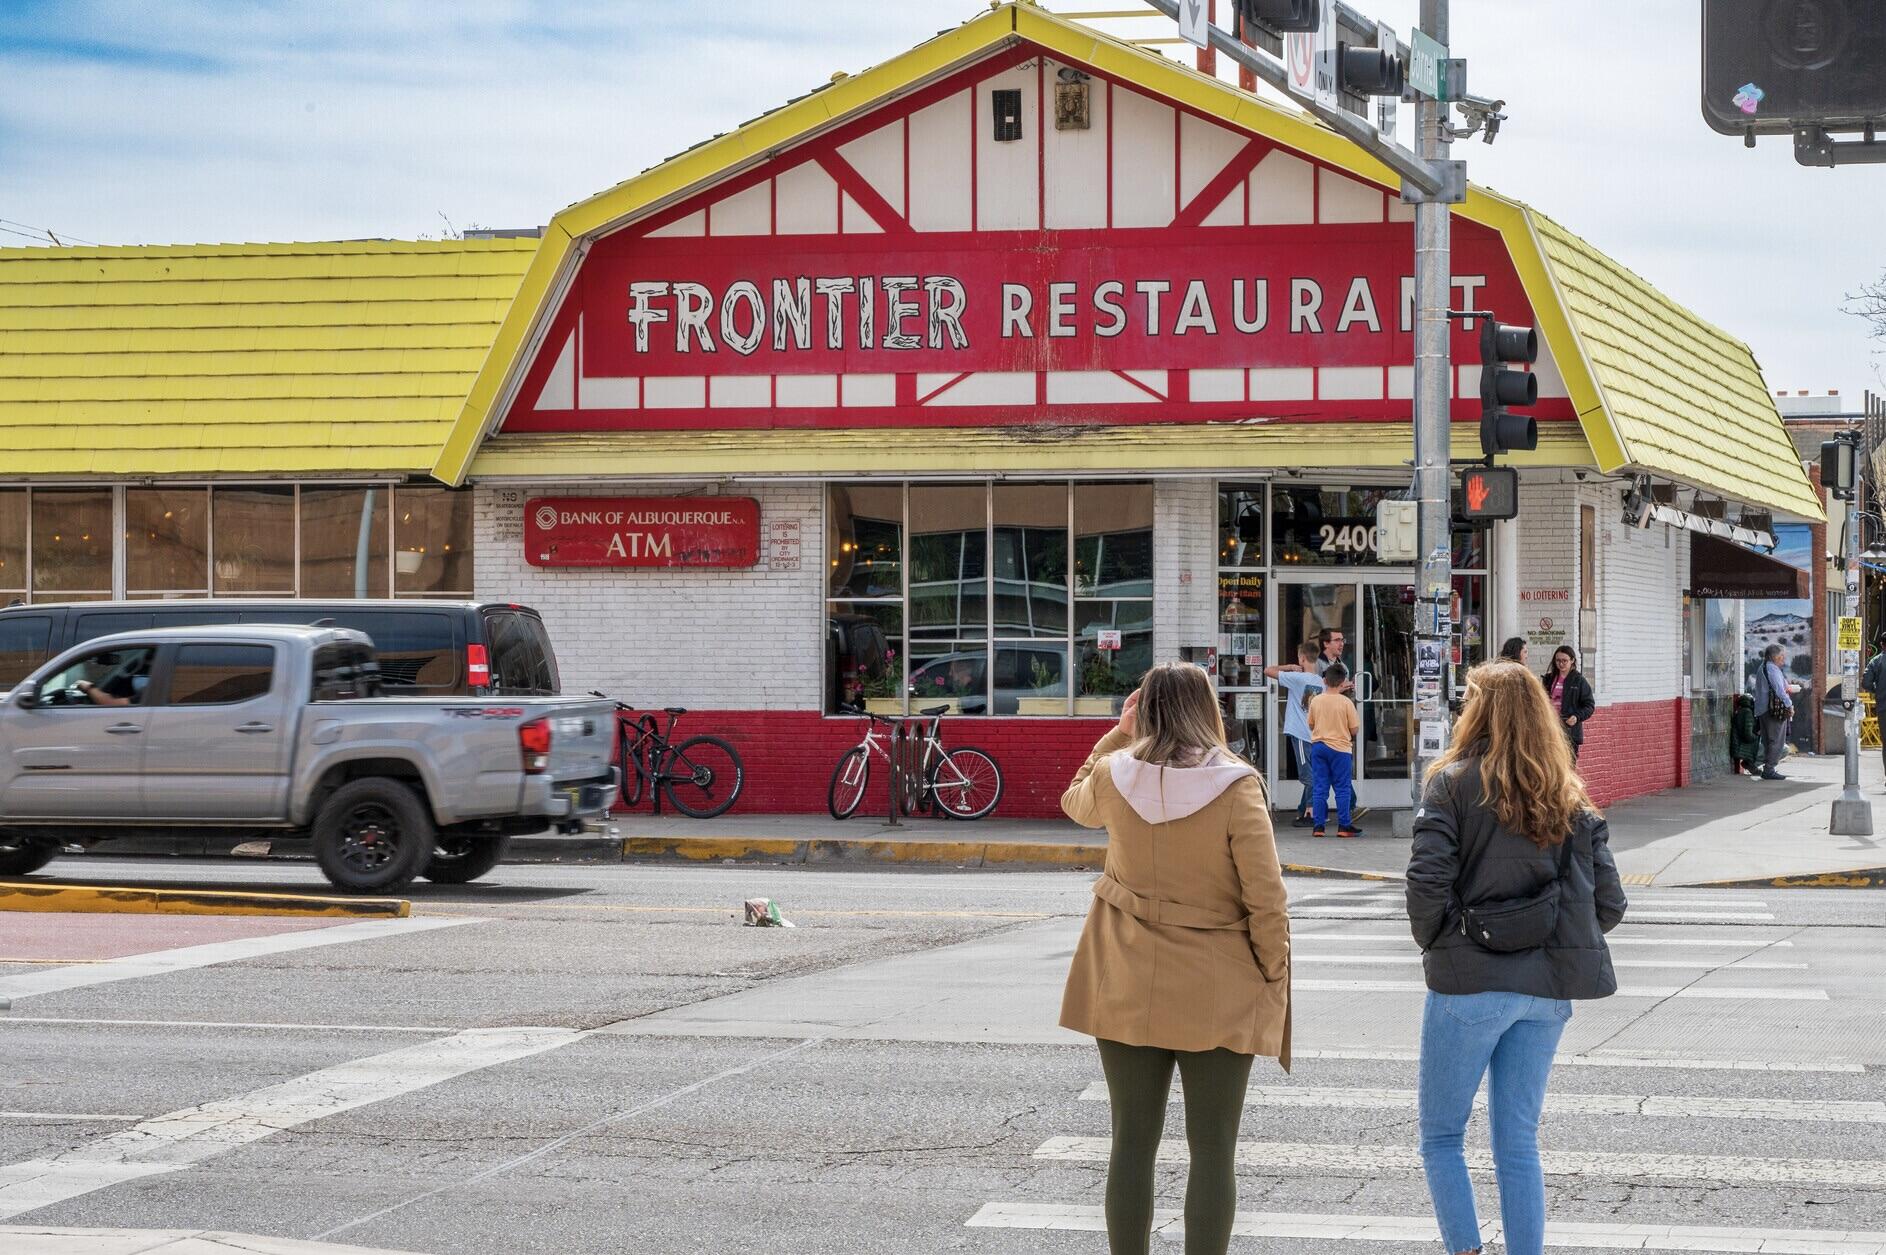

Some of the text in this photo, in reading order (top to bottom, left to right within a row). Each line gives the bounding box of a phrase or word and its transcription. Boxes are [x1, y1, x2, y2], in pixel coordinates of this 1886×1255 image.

[1410, 37, 1437, 90] Cornell
[1318, 70, 1333, 93] ONLY
[628, 275, 970, 356] FRONTIER
[502, 492, 517, 502] NO
[561, 511, 603, 525] BANK
[605, 511, 624, 525] OF
[627, 511, 732, 525] ALBUQUERQUE
[772, 523, 798, 531] LOITERING
[606, 533, 672, 558] ATM
[1215, 577, 1262, 588] Open Daily
[1520, 590, 1569, 601] NO LOITERING
